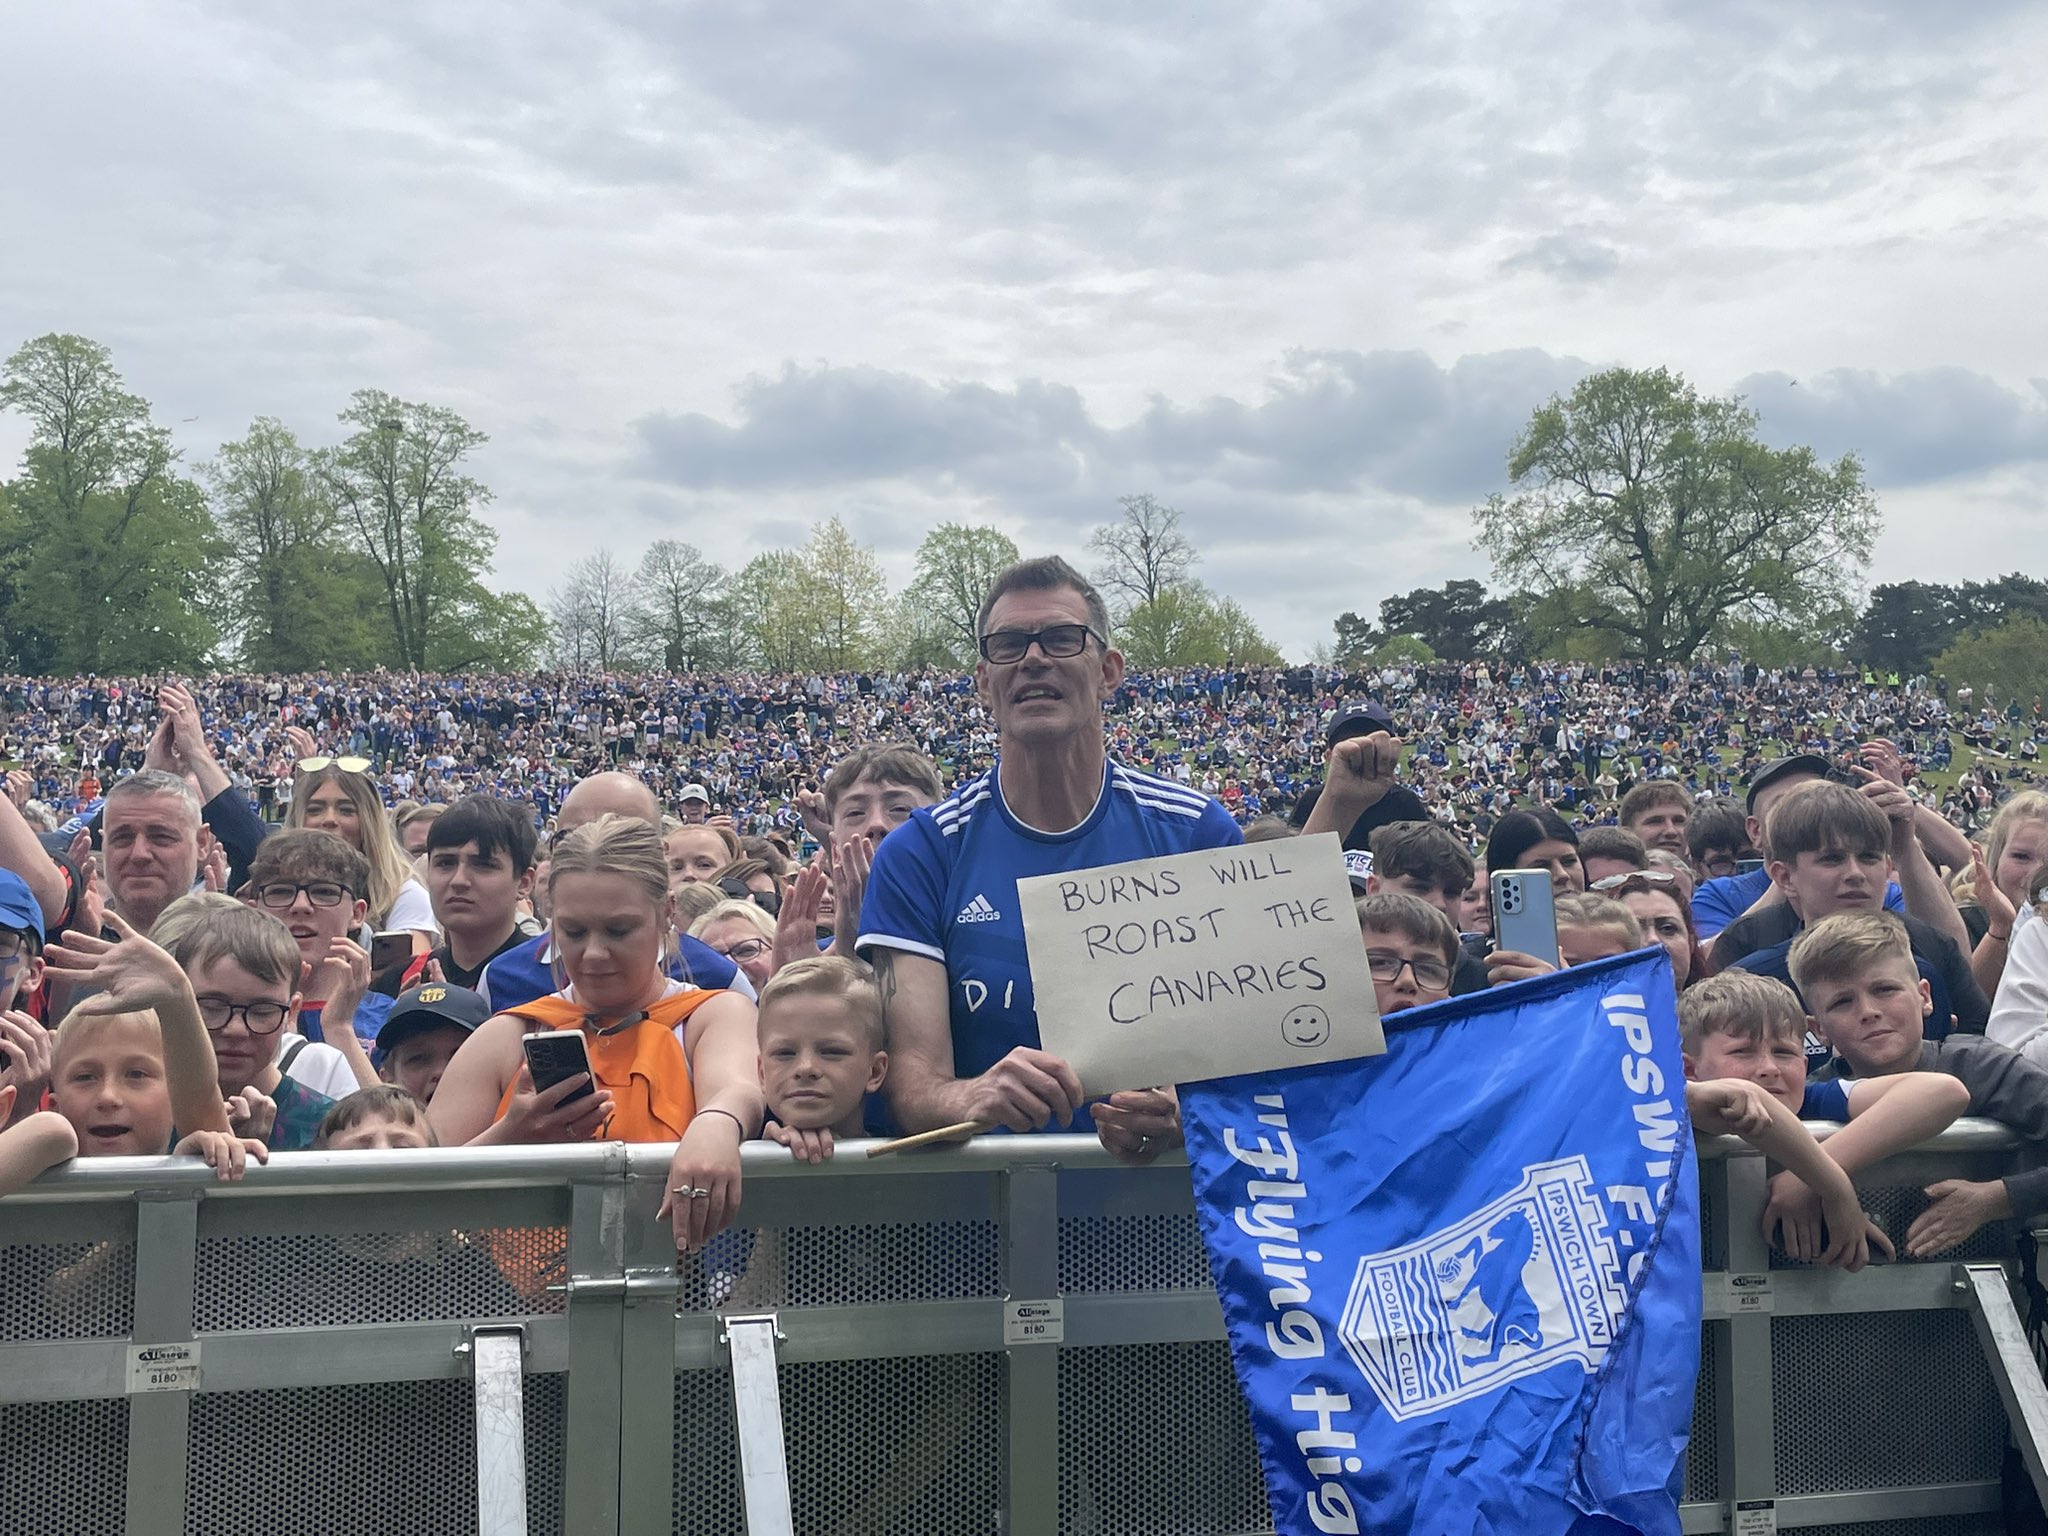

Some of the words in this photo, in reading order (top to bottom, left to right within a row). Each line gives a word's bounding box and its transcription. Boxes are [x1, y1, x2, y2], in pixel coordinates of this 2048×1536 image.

[1058, 871, 1181, 912] BURNS
[1209, 853, 1292, 886] WILL
[956, 910, 1001, 924] adidas
[1081, 907, 1225, 959] ROAST
[1263, 897, 1335, 928] THE
[1108, 956, 1327, 1024] CANARIES
[1547, 1188, 1585, 1271] IPSWICH
[1575, 1272, 1607, 1338] TOWN
[1024, 1325, 1045, 1335] 8180
[1378, 1271, 1408, 1347] FOOTBALL
[1399, 1351, 1418, 1398] CLUB
[151, 1373, 177, 1383] 8180
